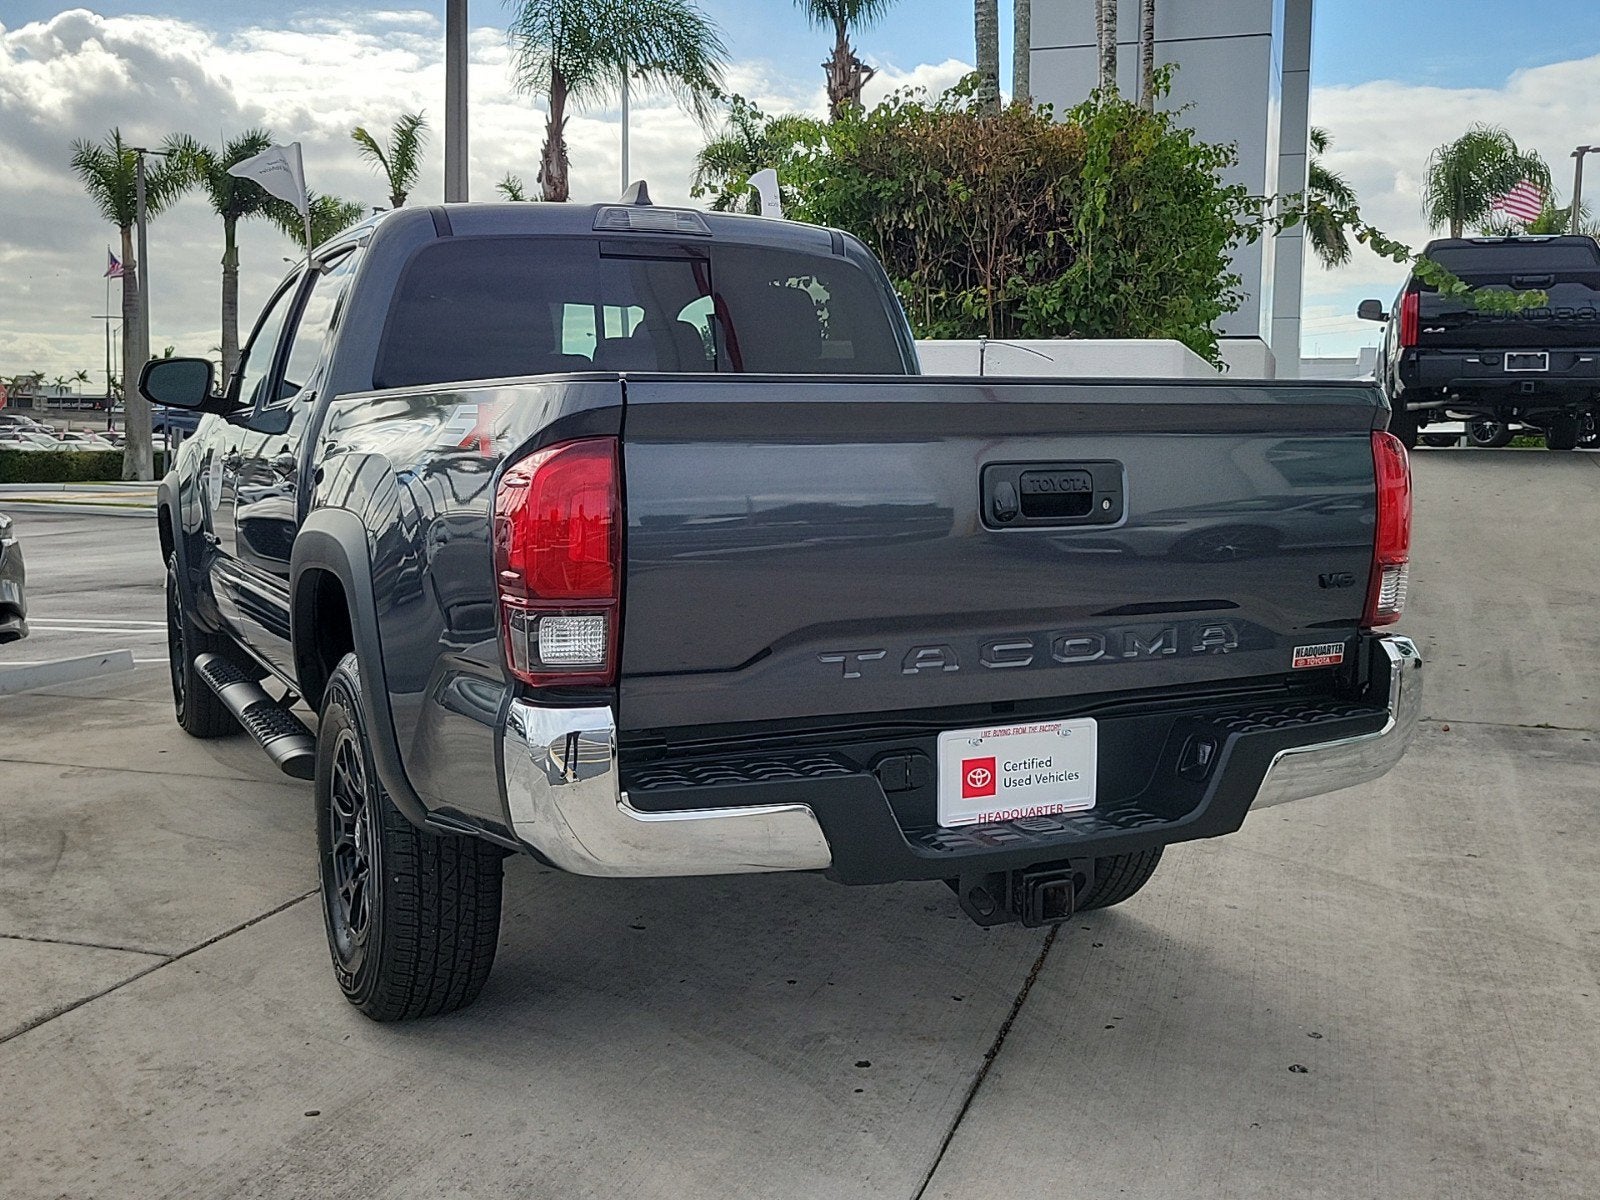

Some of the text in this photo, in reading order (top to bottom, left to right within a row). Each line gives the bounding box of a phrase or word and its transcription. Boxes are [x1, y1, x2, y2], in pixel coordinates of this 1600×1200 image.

[1030, 478, 1090, 492] TOYOTA
[1318, 572, 1356, 589] V6
[816, 622, 1239, 679] TACOMA
[1295, 644, 1343, 657] HEADQUARTER
[1306, 658, 1330, 666] TOYOTA
[981, 730, 992, 738] LIKE
[993, 728, 1011, 737] BUYING
[1012, 727, 1027, 736] FROM
[1028, 726, 1038, 734] THE
[1004, 756, 1052, 772] Certified
[1004, 770, 1080, 788] Used Vehicles
[978, 803, 1064, 824] HEADQUARTER
